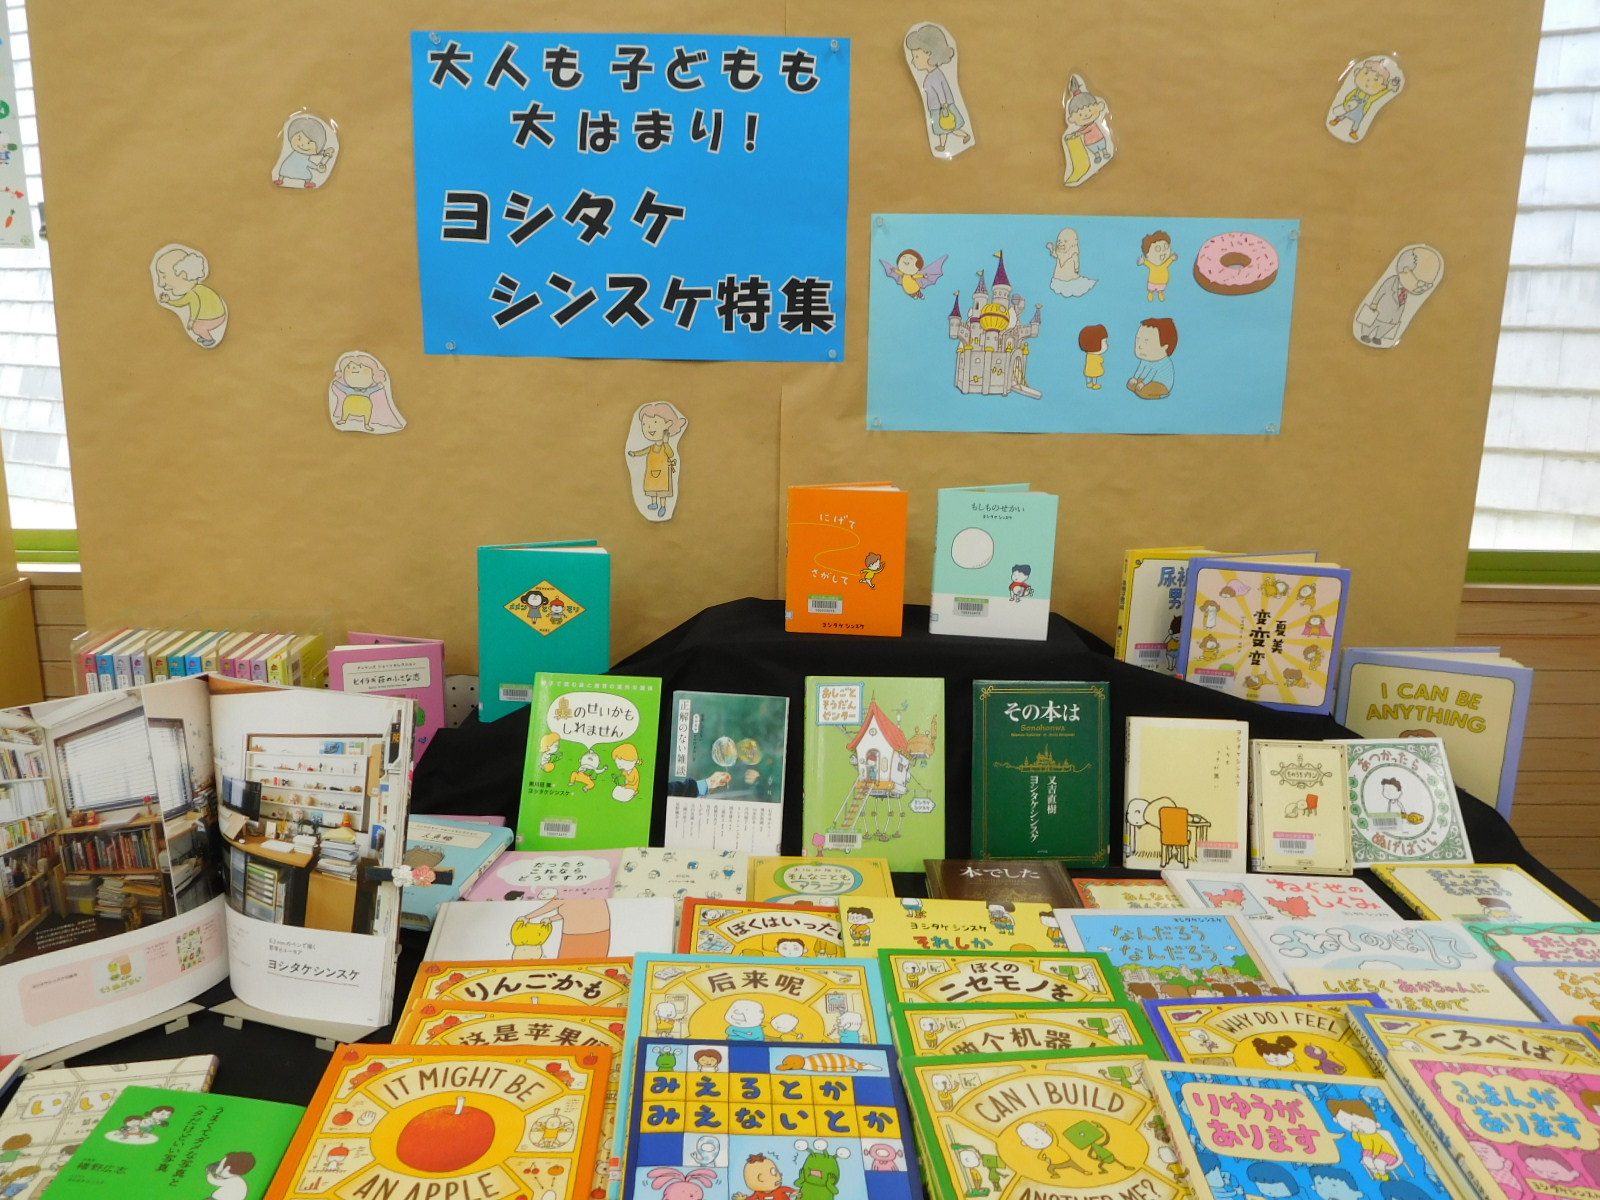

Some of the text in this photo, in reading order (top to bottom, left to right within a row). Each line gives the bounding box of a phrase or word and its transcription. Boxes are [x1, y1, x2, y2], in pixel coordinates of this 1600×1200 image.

[427, 40, 821, 94] 大人も 子どもも
[440, 188, 686, 248] ヨシタケ
[489, 272, 836, 335] シンスケ特集
[971, 502, 1025, 513] もしものせかい
[819, 513, 856, 530] にげて
[811, 568, 850, 586] さがして
[822, 621, 865, 631] ヨシタケ シンスケ
[1271, 620, 1287, 655] 夏美
[353, 672, 420, 686] ヒイラギ荘の小さな恋
[821, 687, 857, 699] おしごと
[822, 699, 857, 710] そうだん
[1381, 682, 1483, 711] I CAN BE
[554, 697, 634, 721] 鼻のせいかも
[822, 711, 857, 721] センター
[1004, 700, 1081, 723] その本は
[1366, 703, 1487, 734] ANYTHING
[563, 722, 624, 738] しれません
[676, 700, 690, 776] 正解のない雑談
[1357, 749, 1420, 772] あつかったら
[1287, 771, 1318, 779] そのうちプラン
[1046, 775, 1058, 815] 又吉直樹
[1029, 775, 1040, 843] ヨシタケシンスケ
[1371, 831, 1438, 856] ぬげばいい
[530, 867, 582, 875] これなら
[960, 866, 1041, 879] 本でした
[1266, 878, 1364, 893] ねぐせの
[1311, 894, 1381, 909] しくみ
[911, 922, 987, 932] ヨシタケ シンスケ
[1110, 925, 1207, 942] なんだろう
[913, 935, 994, 950] それしか
[1120, 944, 1218, 963] なんだろう
[267, 959, 360, 981] ヨシタケシンスケ
[971, 962, 1020, 974] ぼくの
[464, 972, 603, 1001] りんごかも
[707, 970, 805, 997] 后来呢
[940, 975, 1074, 1002] ニセモノを
[1217, 1011, 1339, 1036] WHY DO I FEEL
[1430, 1028, 1555, 1062] ころべば
[383, 1065, 546, 1103] IT MIGHT BE
[649, 1075, 848, 1101] みえるとか
[1451, 1080, 1561, 1111] ふまんが
[974, 1081, 1125, 1124] CAN I BUILD
[1192, 1091, 1305, 1126] りゆうが
[647, 1103, 894, 1134] みえないとか
[1473, 1106, 1582, 1141] あります
[1206, 1117, 1321, 1156] あります
[352, 1172, 501, 1200] AN APPLE
